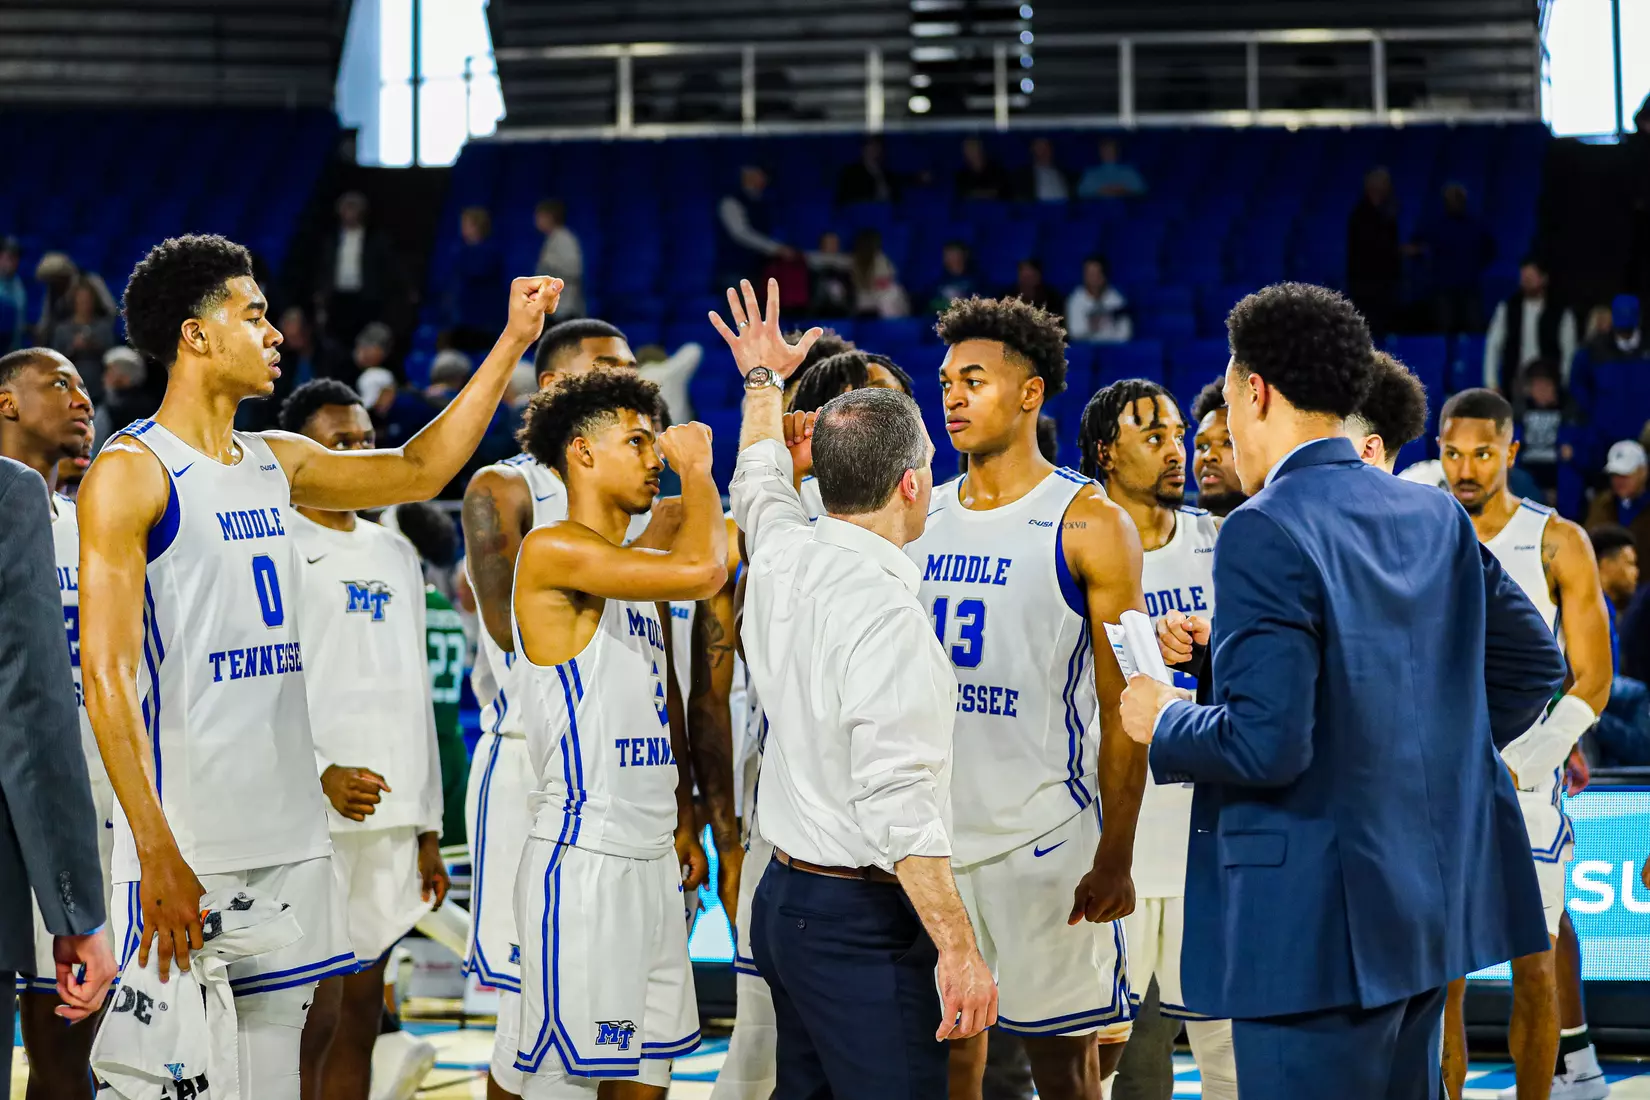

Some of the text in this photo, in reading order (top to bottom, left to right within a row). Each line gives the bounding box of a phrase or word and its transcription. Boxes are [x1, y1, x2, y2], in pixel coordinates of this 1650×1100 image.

[215, 507, 286, 541] MIDDLE
[923, 554, 1012, 586] MIDDLE
[251, 552, 284, 630] 0
[931, 595, 988, 671] 13
[595, 1021, 637, 1051] MT
